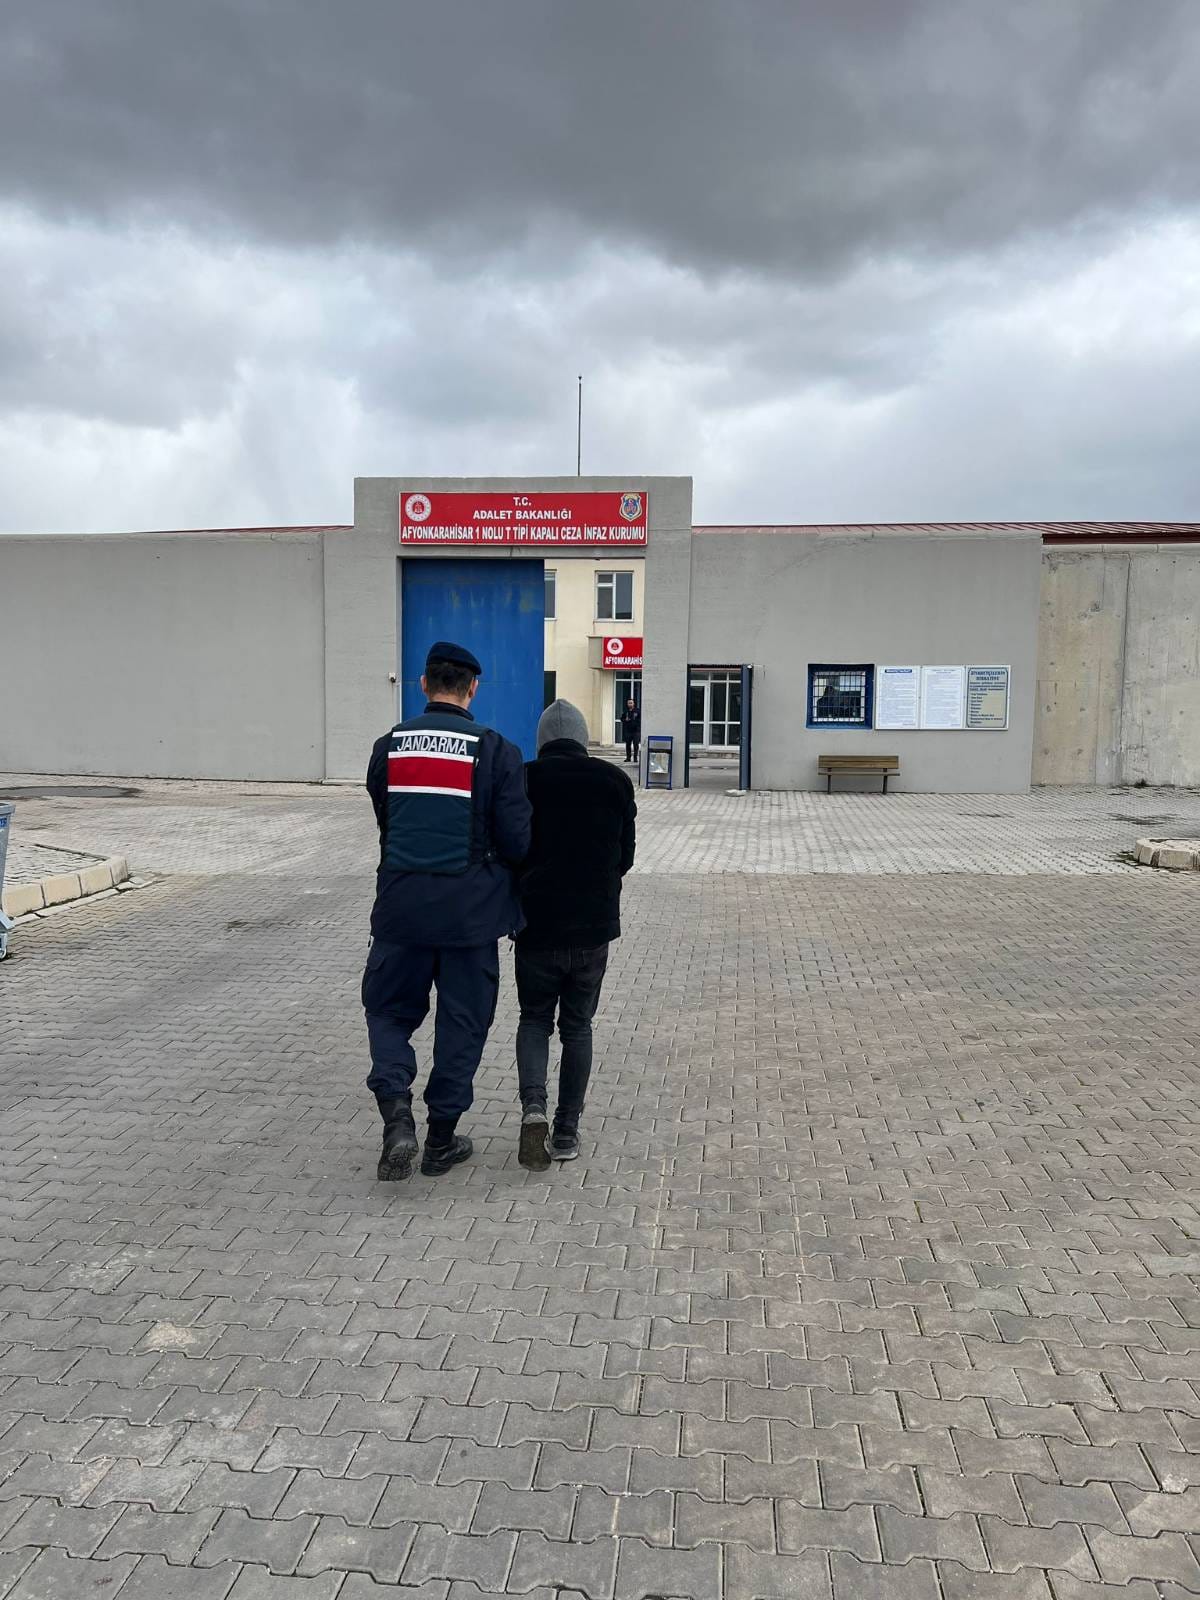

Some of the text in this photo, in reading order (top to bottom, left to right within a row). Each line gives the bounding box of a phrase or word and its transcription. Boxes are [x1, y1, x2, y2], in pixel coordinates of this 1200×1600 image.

[513, 497, 532, 506] T.C.
[473, 508, 572, 520] ADALET BAKANLIĞI
[402, 523, 645, 540] AFYONKARAHİSAR 1 NOLU T TİPİ KAPALI CEZA İNFAZ KURUMU
[396, 735, 468, 755] JANDARMA
